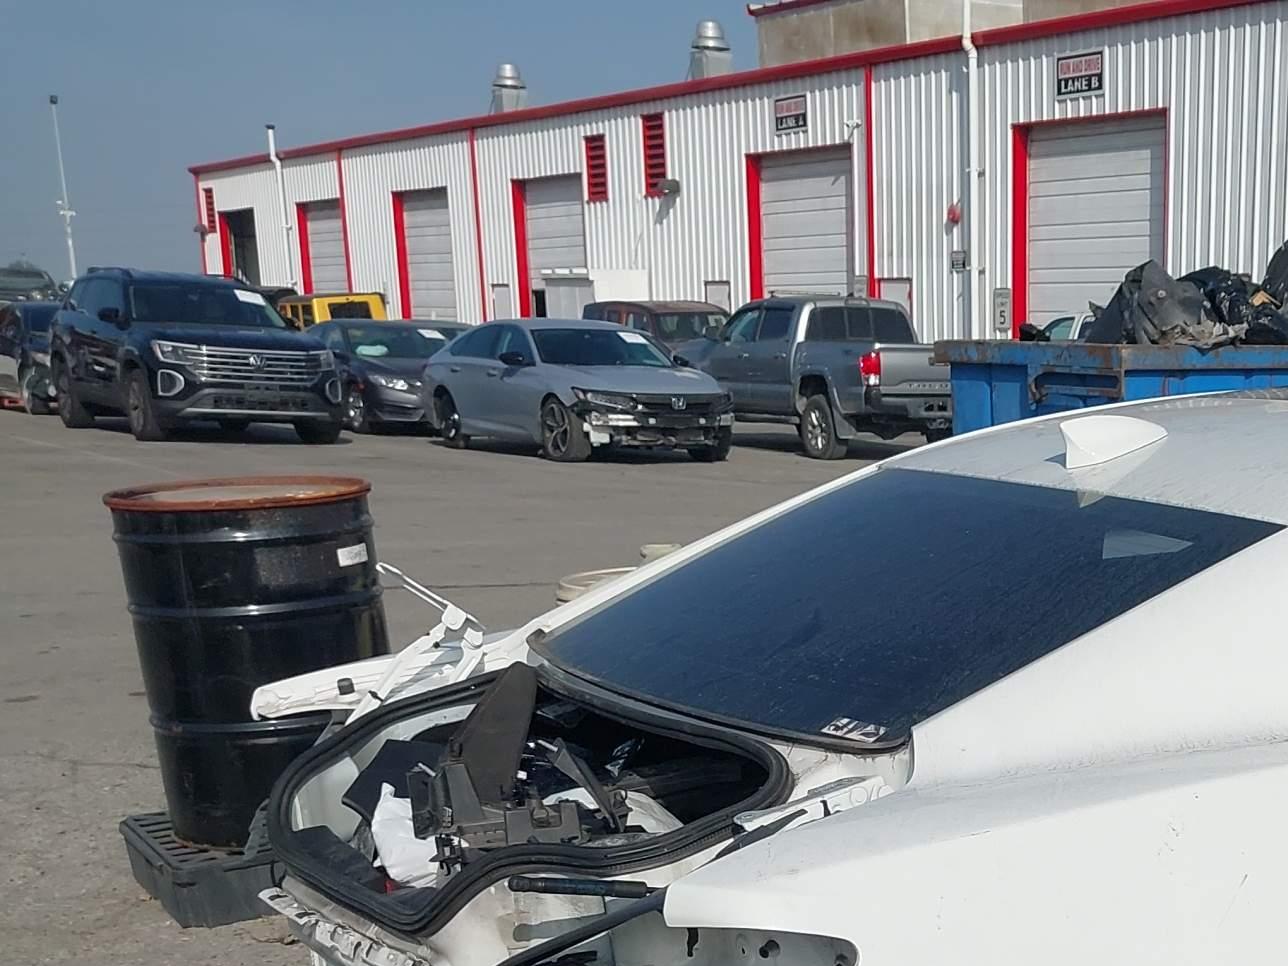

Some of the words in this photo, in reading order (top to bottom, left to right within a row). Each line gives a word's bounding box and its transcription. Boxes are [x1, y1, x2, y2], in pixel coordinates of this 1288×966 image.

[1061, 76, 1090, 93] LANE
[1091, 75, 1100, 89] B
[999, 310, 1007, 326] 5
